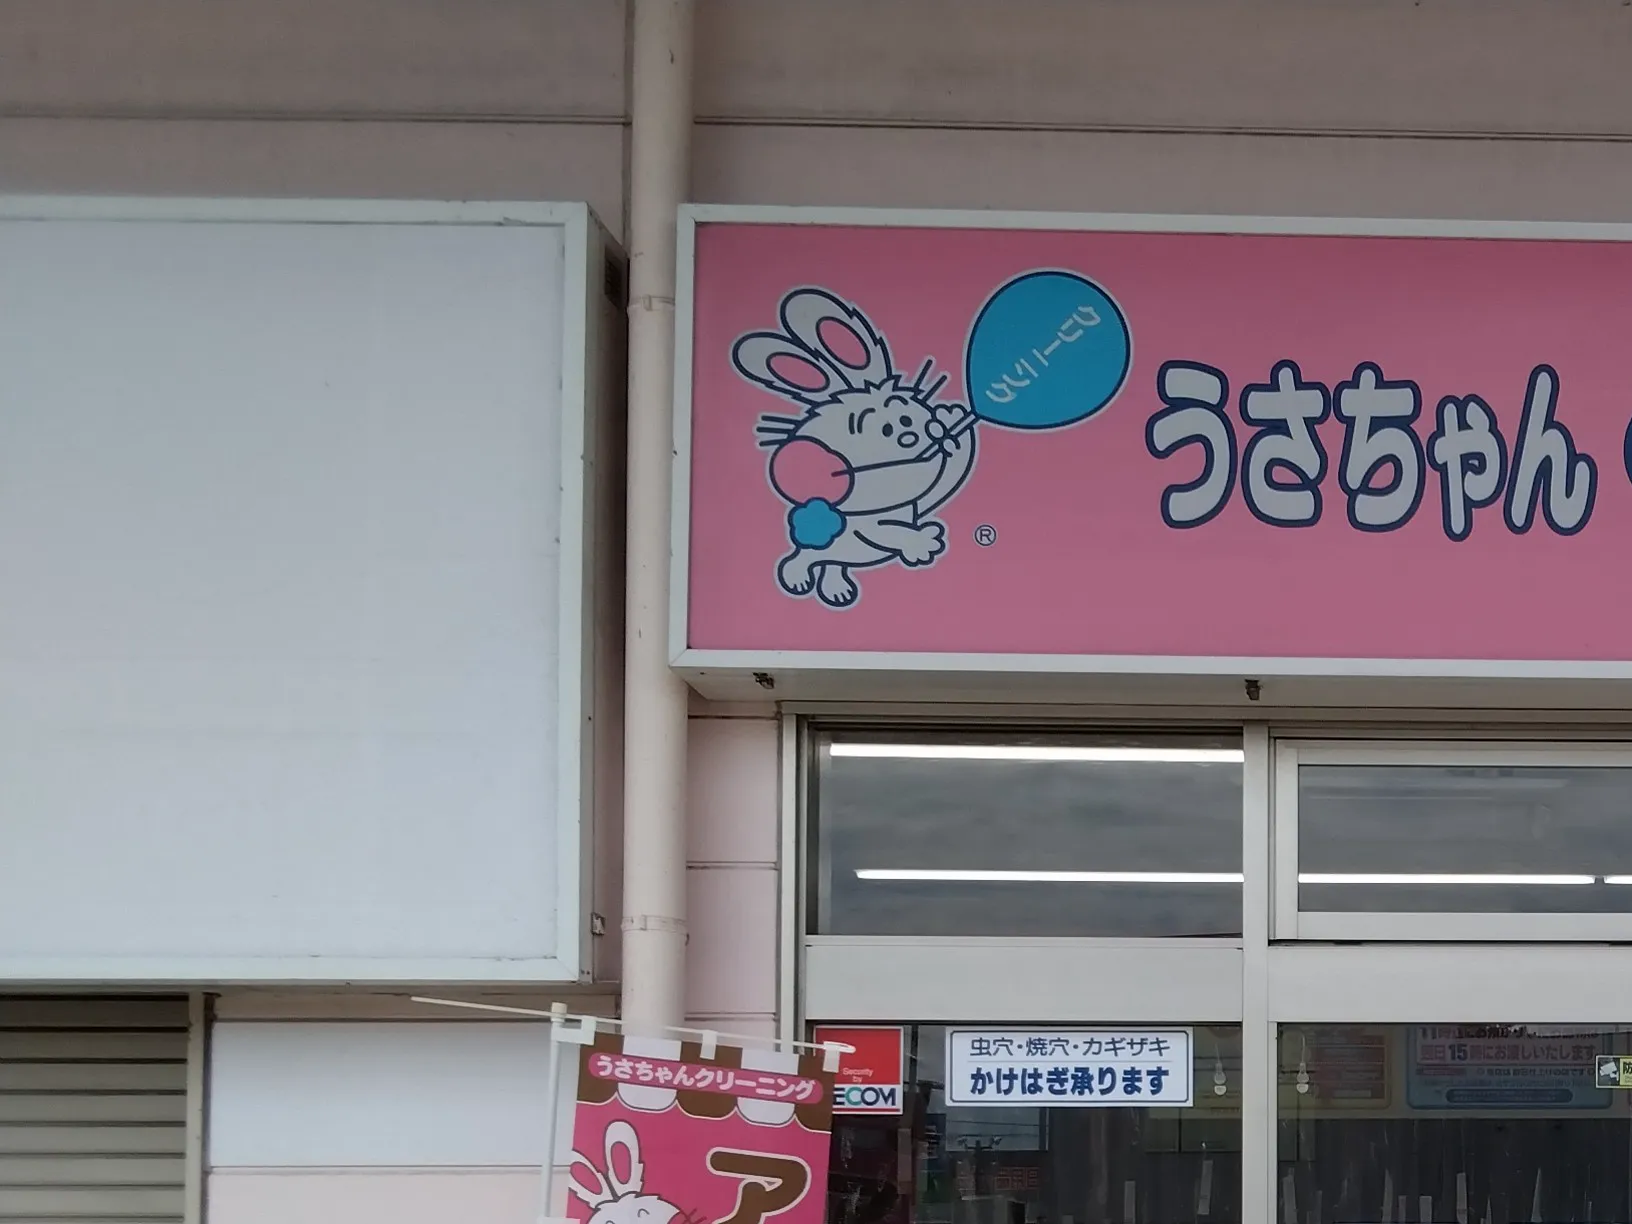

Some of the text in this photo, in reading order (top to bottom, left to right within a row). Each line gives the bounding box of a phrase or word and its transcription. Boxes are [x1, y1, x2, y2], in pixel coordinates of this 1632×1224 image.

[985, 306, 1101, 403] クリーニング
[1146, 360, 1597, 541] うさちゃん
[970, 1036, 1171, 1058] 虫穴・焼穴・カギザキ
[596, 1055, 816, 1101] うさちゃんクリーニング
[834, 1086, 897, 1107] ECOM
[970, 1065, 1170, 1097] かけはぎ承ります
